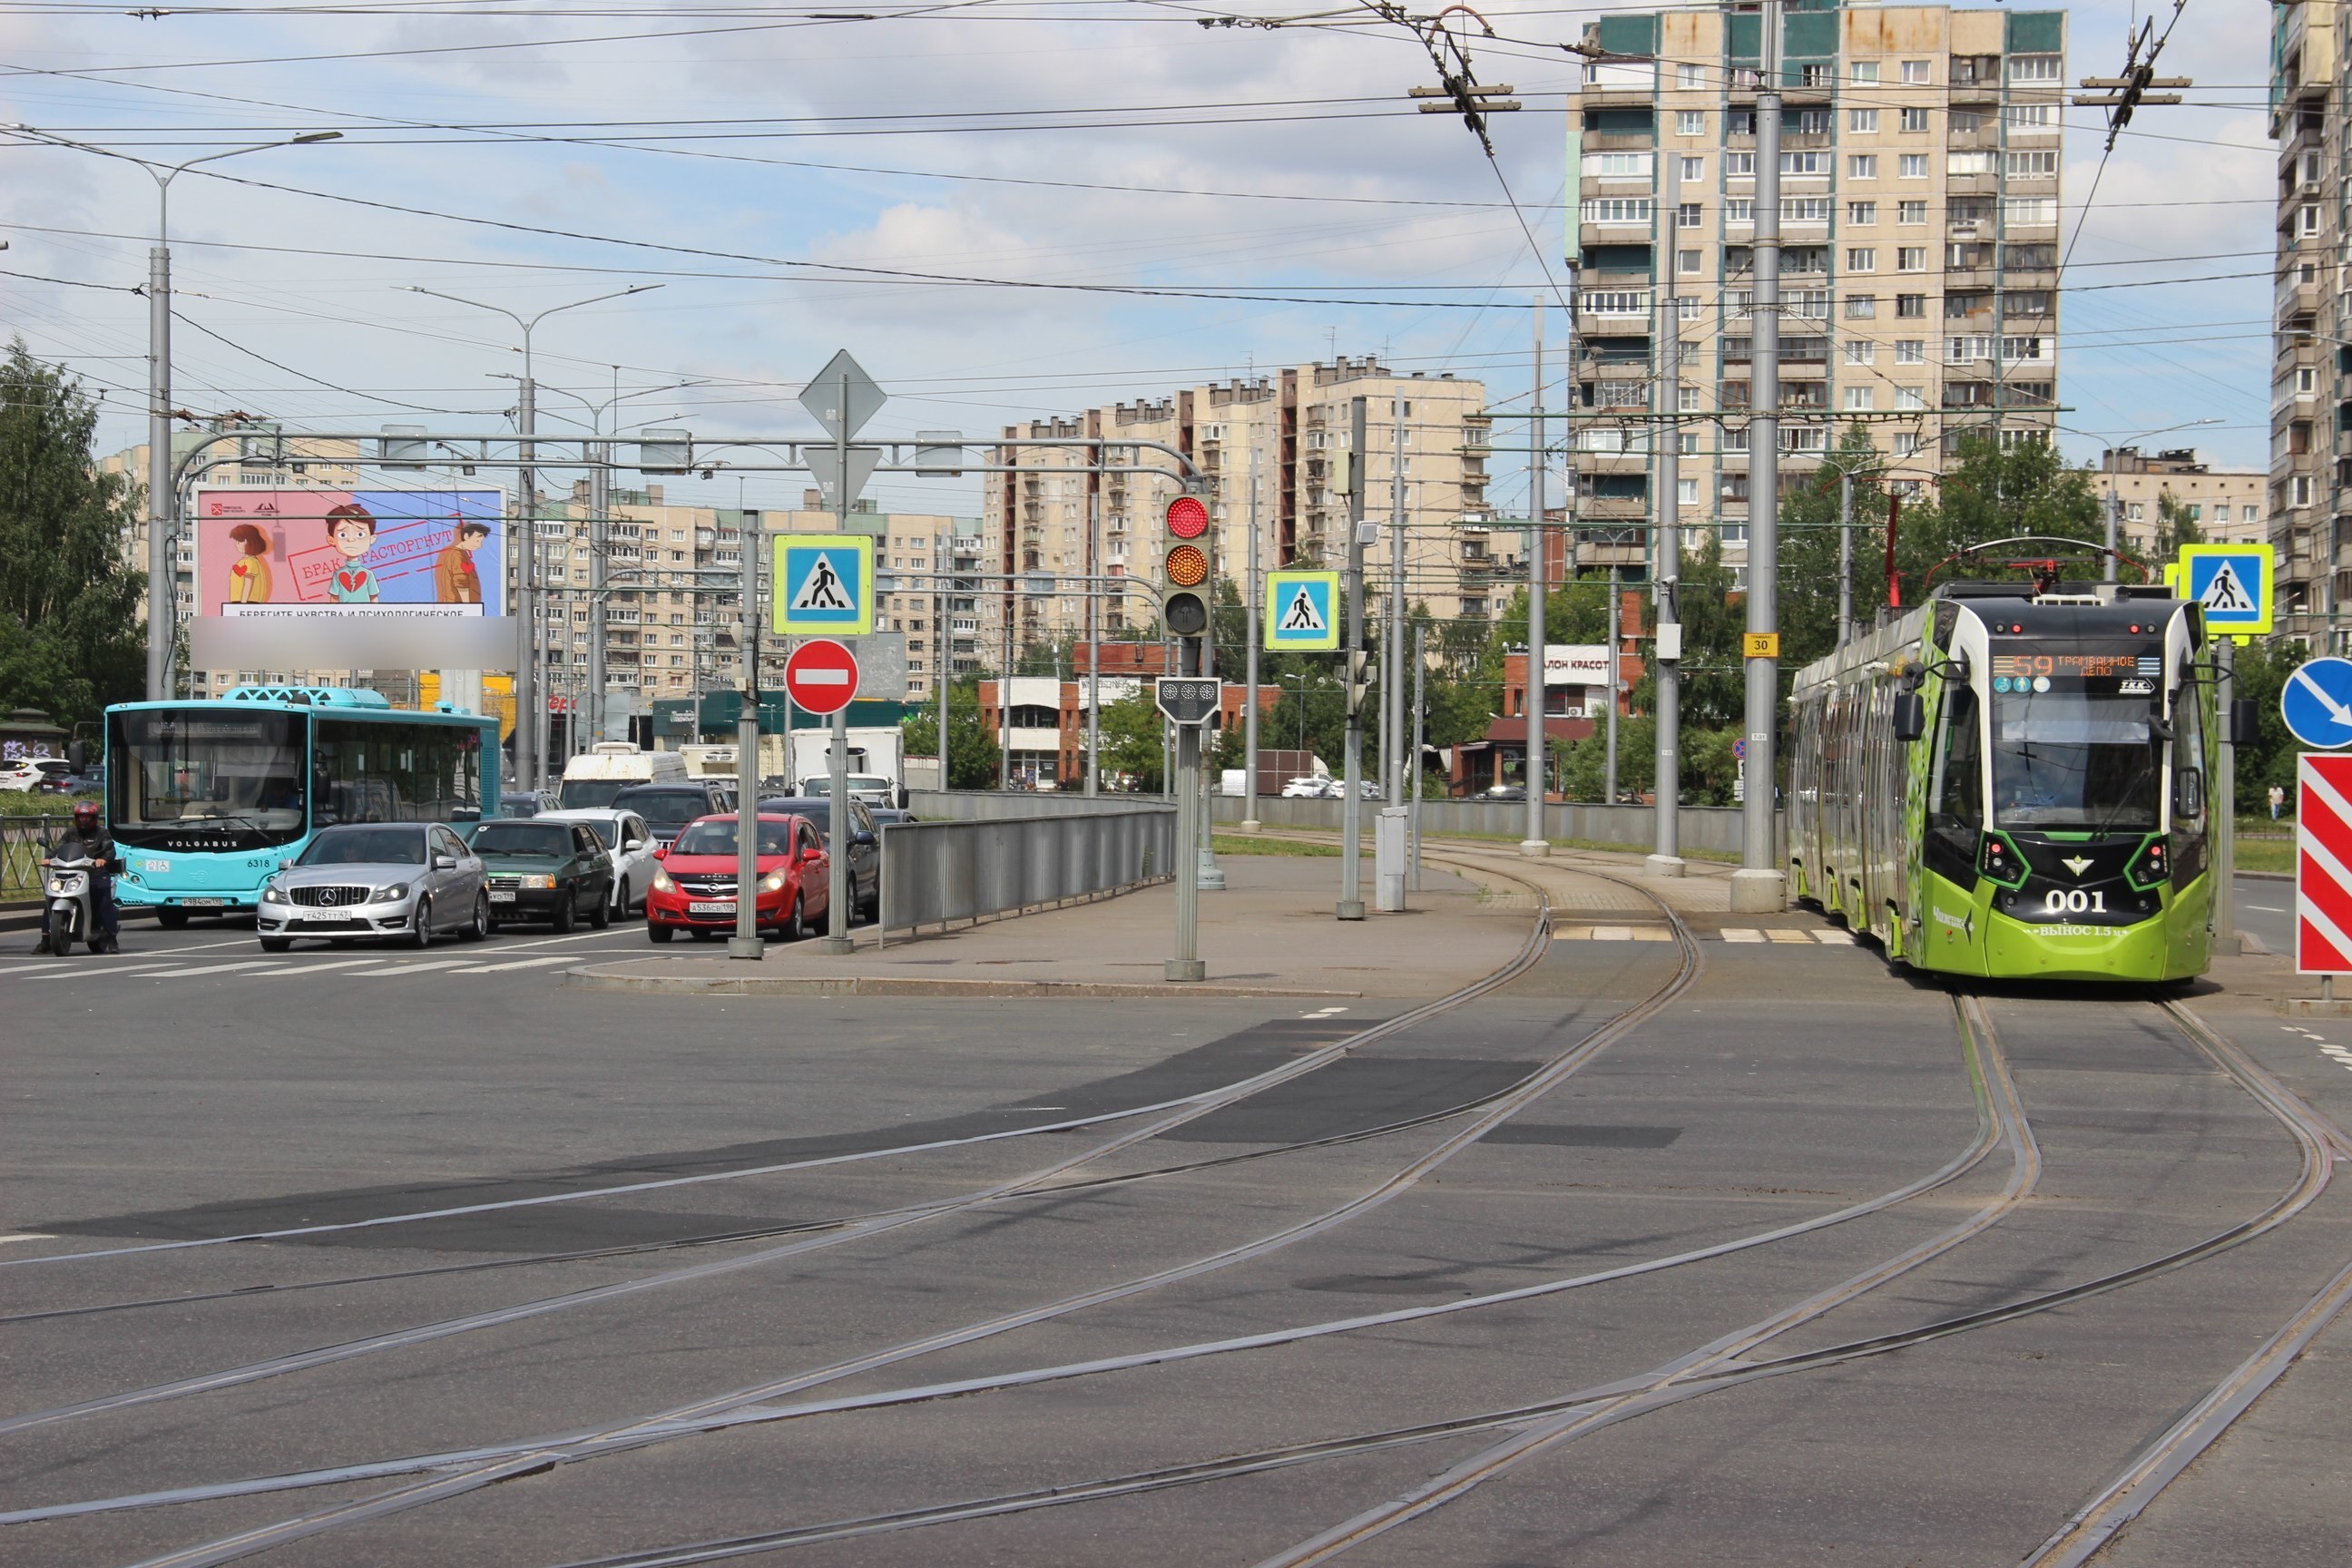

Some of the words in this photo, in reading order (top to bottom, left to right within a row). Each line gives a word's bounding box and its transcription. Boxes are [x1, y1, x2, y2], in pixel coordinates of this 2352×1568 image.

[302, 558, 342, 579] БРАК
[360, 530, 452, 564] РАСТОРГНУТ
[1754, 640, 1769, 651] 30
[1571, 660, 1610, 671] КРАСОТ
[2014, 655, 2053, 677] 59
[2080, 666, 2113, 677] ДЕПО
[247, 859, 270, 868] 6318
[2045, 889, 2107, 913] 001
[2040, 926, 2092, 936] ВЫНОС
[2094, 926, 2112, 936] 1.5
